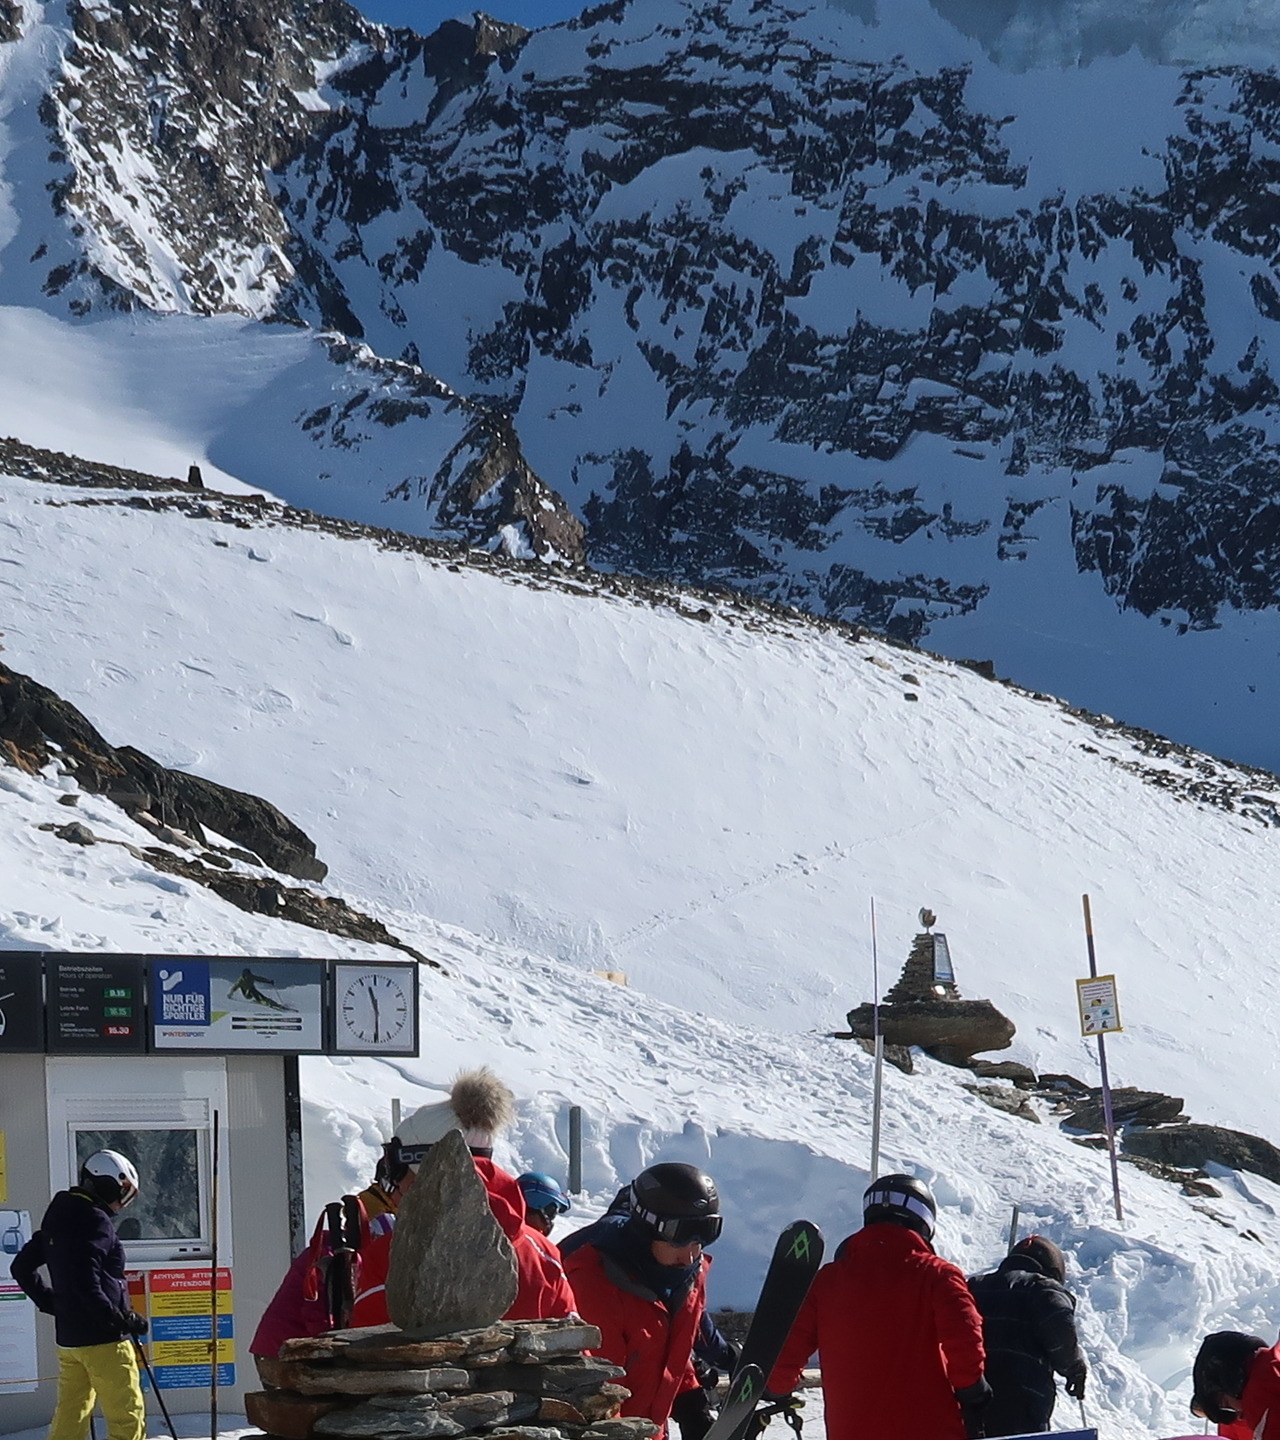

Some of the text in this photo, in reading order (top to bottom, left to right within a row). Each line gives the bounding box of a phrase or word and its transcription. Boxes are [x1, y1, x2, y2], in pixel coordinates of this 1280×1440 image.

[162, 992, 205, 1004] NUR FÜR
[163, 1003, 205, 1012] RICHTIGE
[163, 1012, 205, 1020] SPORTLER
